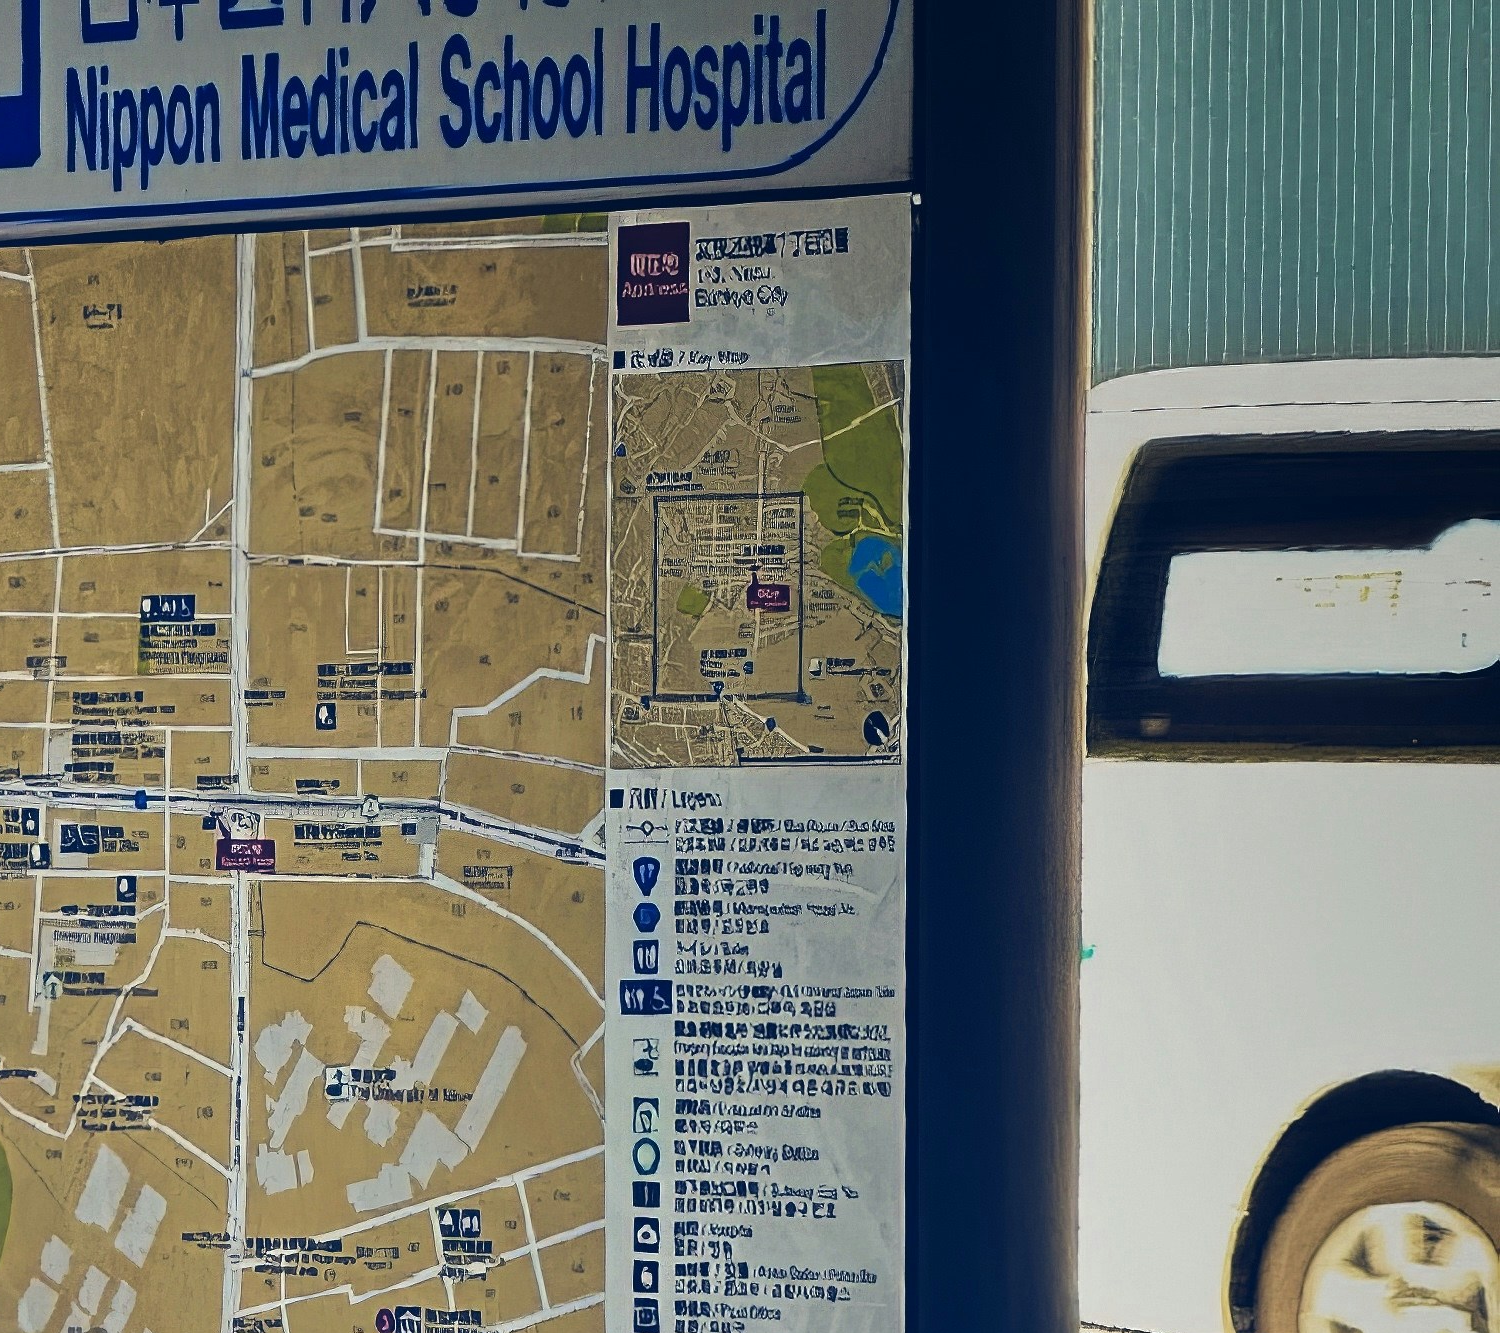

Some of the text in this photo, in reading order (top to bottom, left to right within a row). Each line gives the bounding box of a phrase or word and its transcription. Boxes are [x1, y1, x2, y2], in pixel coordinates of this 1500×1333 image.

[67, 9, 826, 192] Nippon Medical School Hospital
